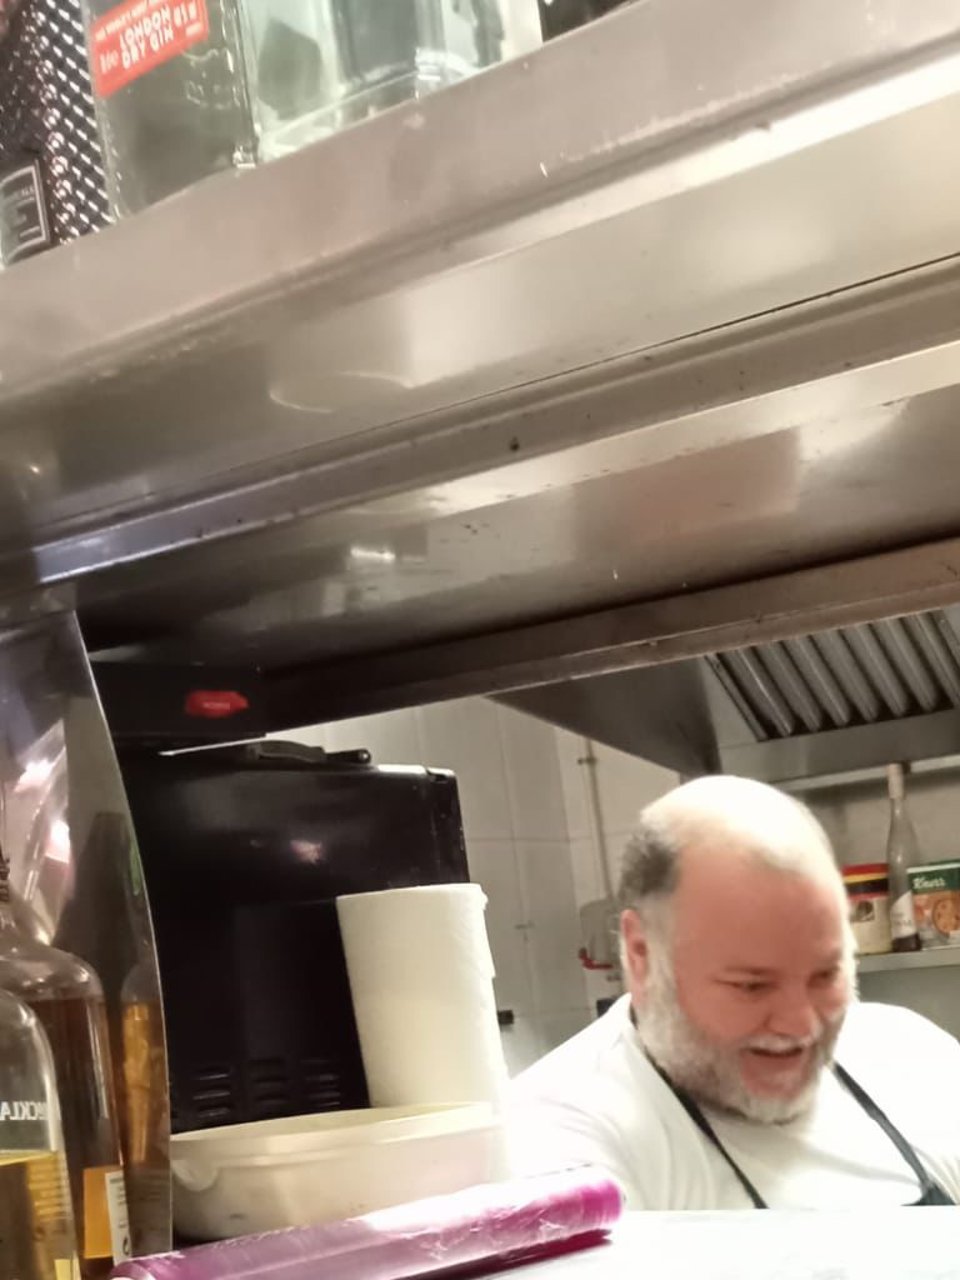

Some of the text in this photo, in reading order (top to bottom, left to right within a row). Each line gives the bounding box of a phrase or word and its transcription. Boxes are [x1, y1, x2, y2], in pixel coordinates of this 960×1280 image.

[119, 3, 171, 50] LONDON
[122, 40, 146, 70] DRY
[150, 26, 174, 52] GIN
